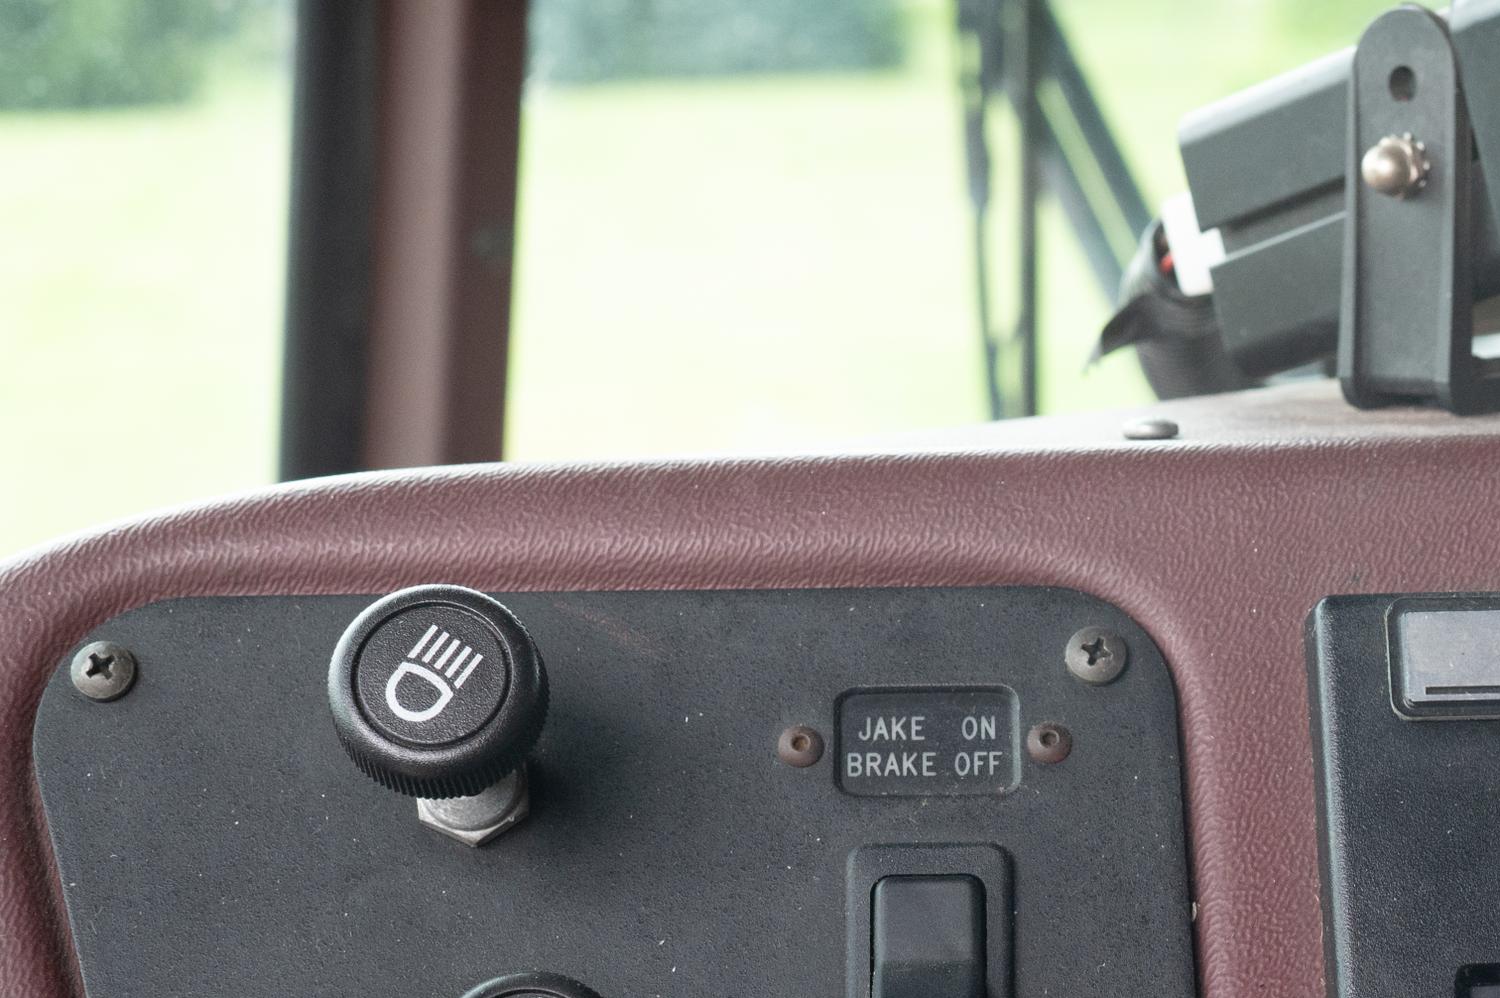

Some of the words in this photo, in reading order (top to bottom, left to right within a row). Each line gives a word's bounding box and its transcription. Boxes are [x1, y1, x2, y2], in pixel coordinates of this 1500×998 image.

[858, 716, 926, 741] JAKE
[961, 716, 996, 741] ON
[846, 752, 937, 777] BRAKE
[954, 752, 1003, 776] OFF
